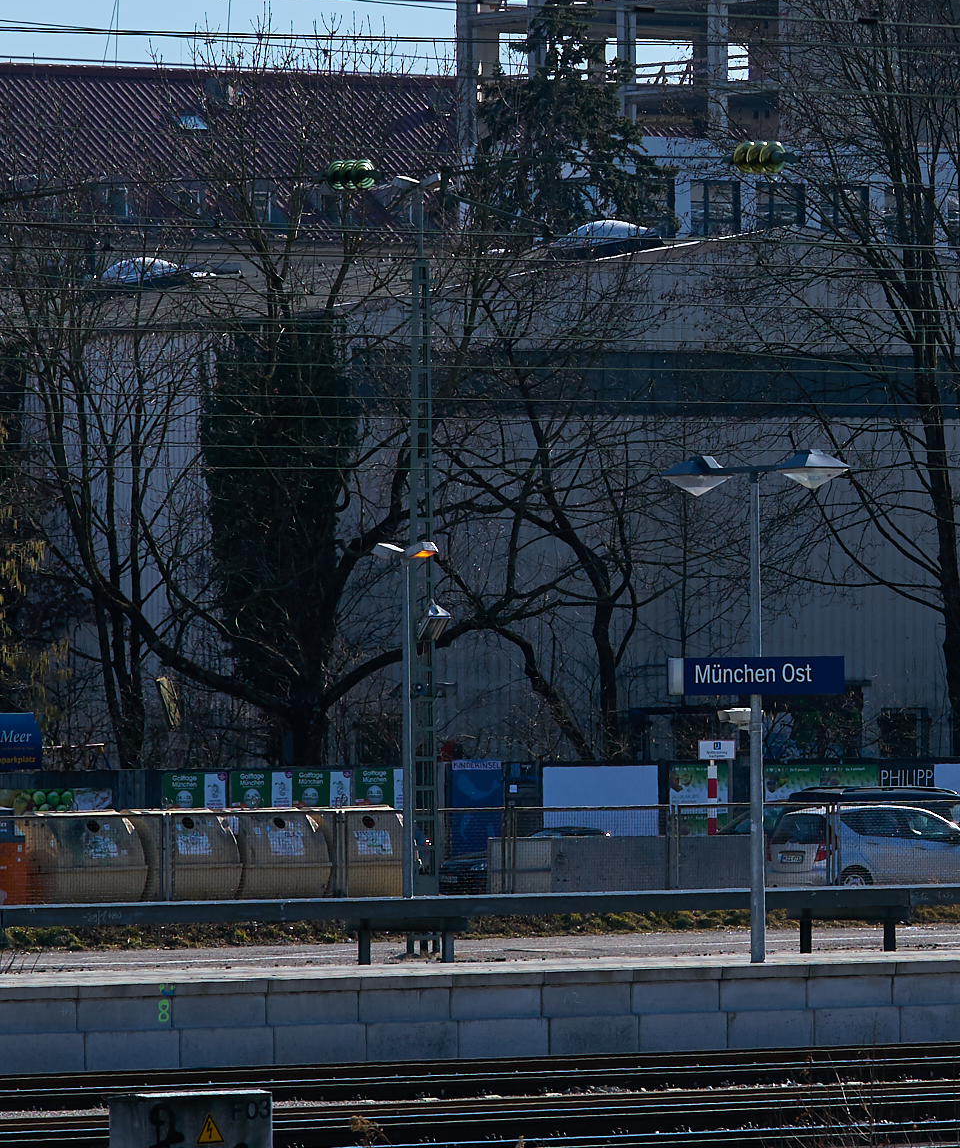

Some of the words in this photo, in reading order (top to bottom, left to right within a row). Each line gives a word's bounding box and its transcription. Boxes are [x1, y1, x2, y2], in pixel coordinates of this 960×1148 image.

[694, 663, 776, 685] München
[781, 662, 813, 684] Ost
[0, 729, 32, 743] Meer
[453, 760, 501, 769] KINDERINSEL
[880, 768, 934, 786] PHILIPP
